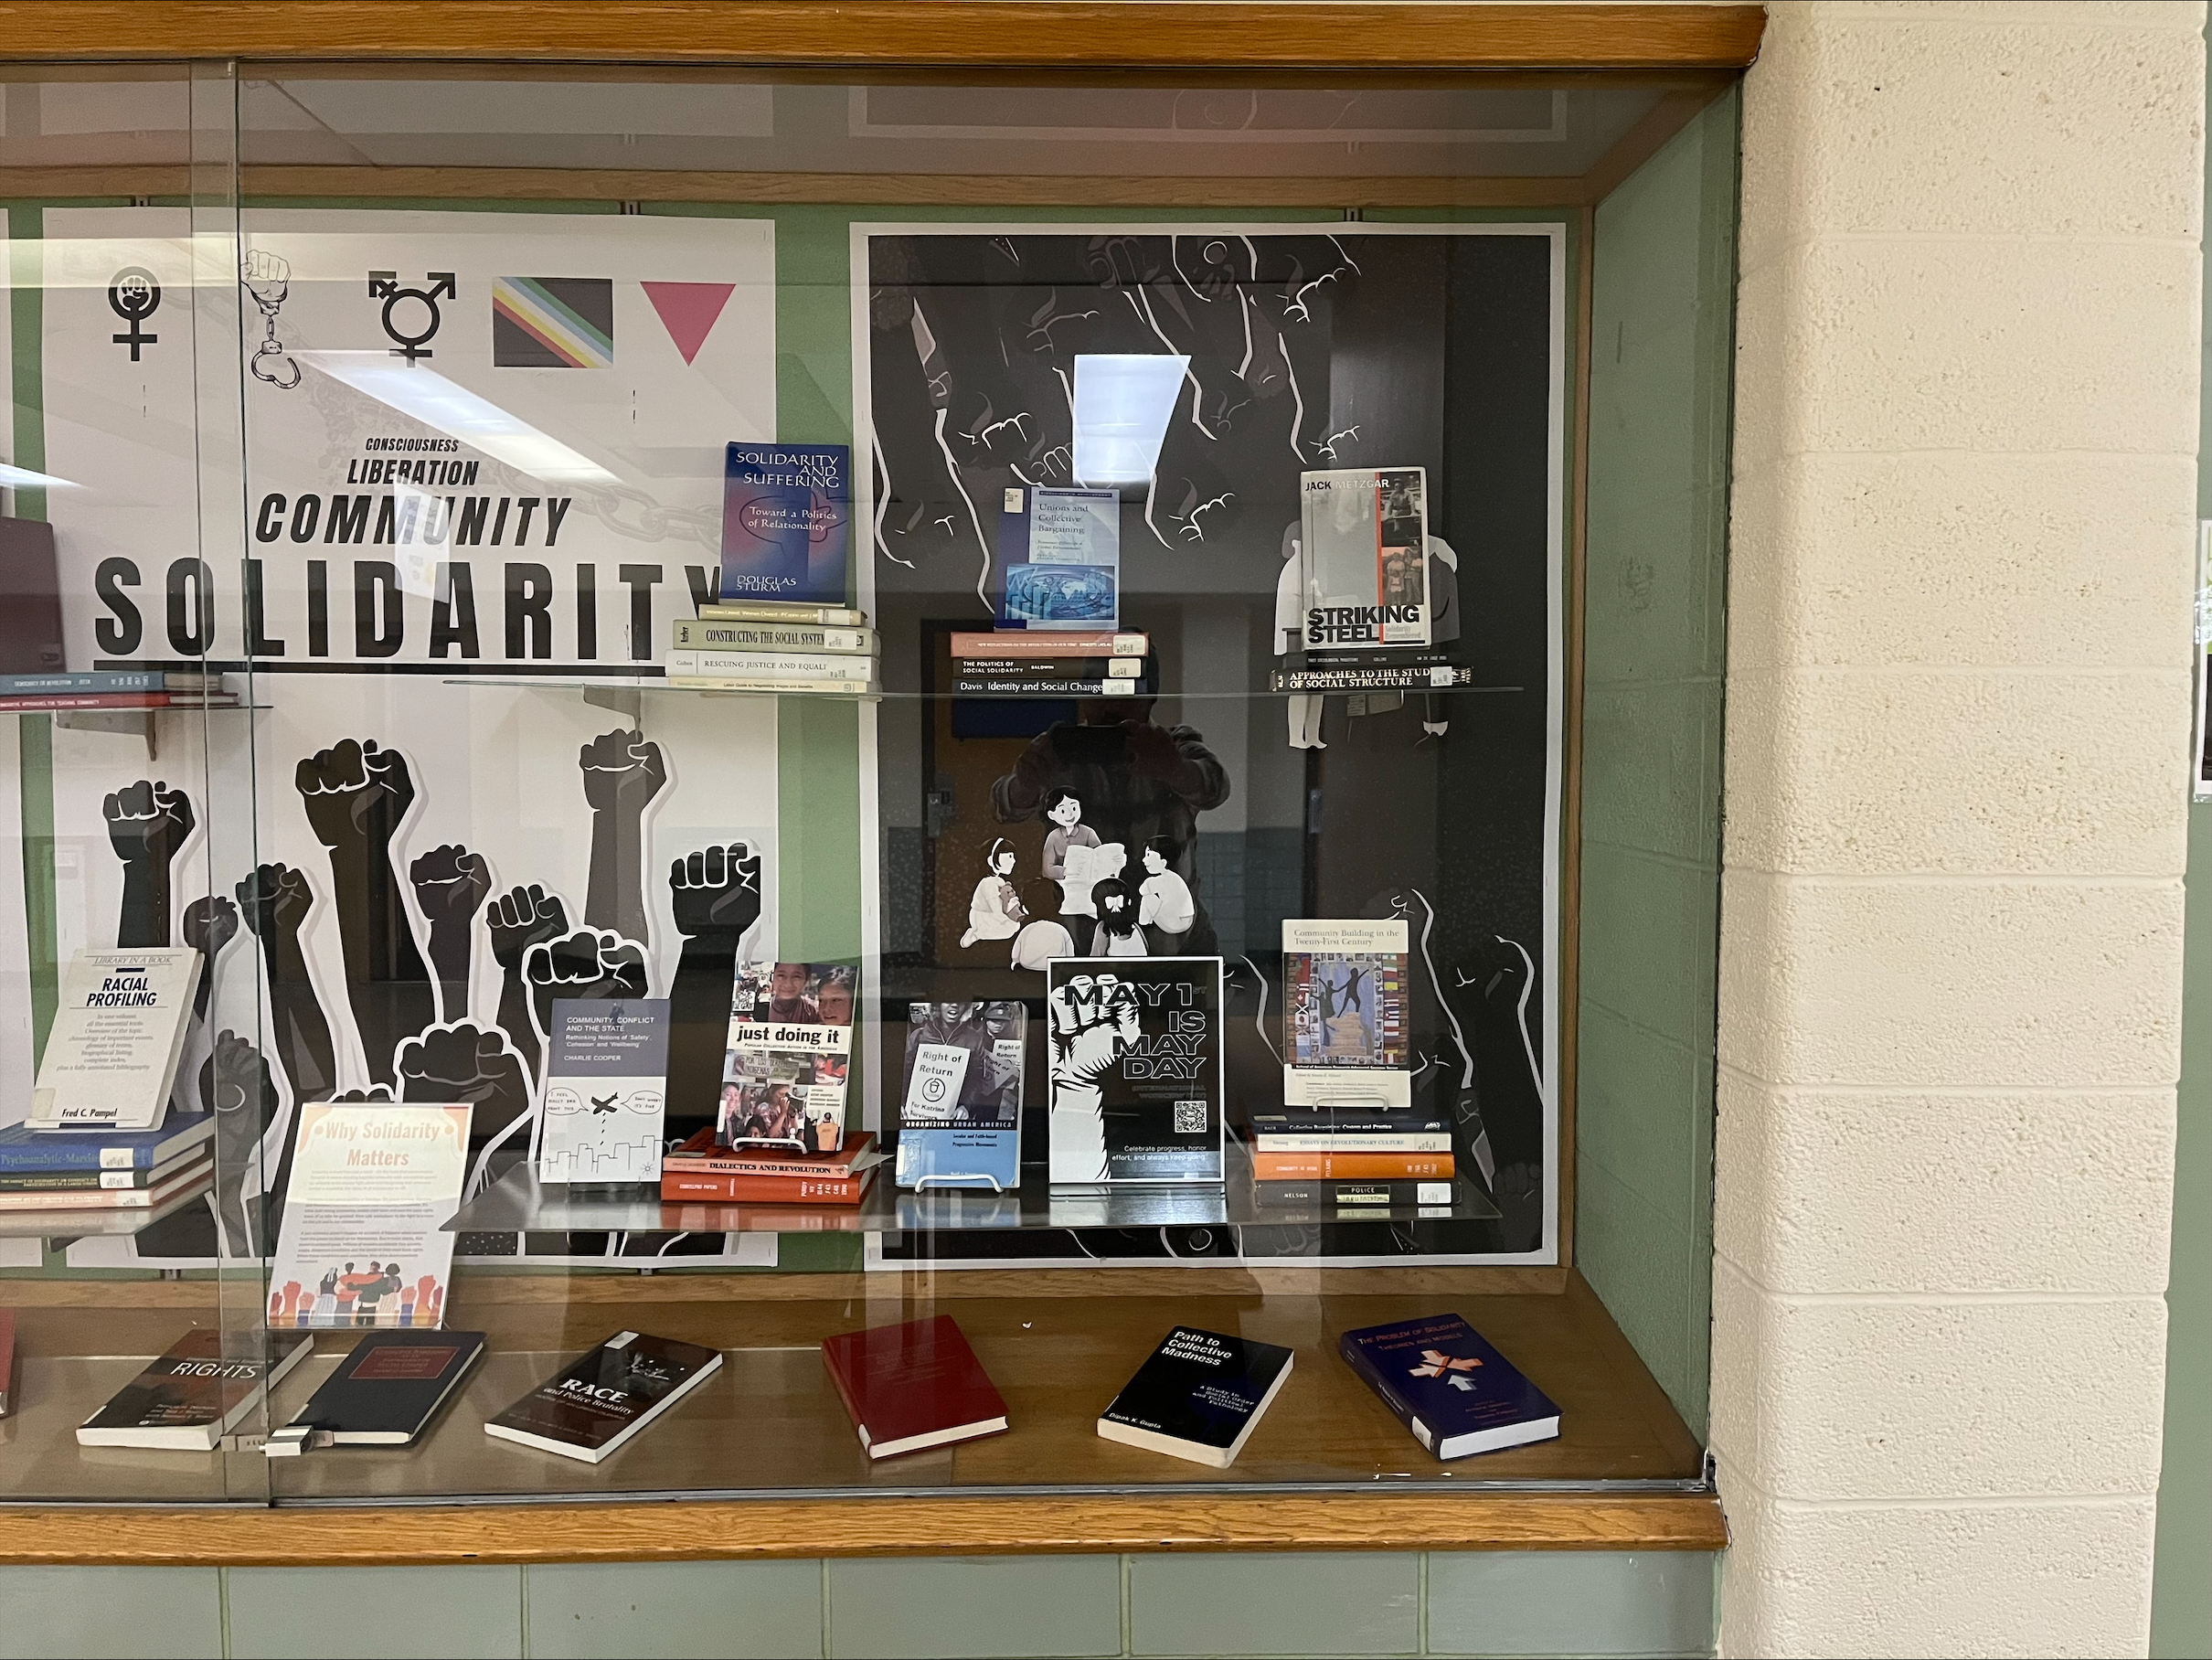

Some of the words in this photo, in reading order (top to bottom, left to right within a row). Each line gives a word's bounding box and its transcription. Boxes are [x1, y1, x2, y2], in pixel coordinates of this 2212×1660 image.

[365, 437, 459, 453] CONSCIOUSNESS
[735, 451, 839, 467] SOLIDARITY
[346, 459, 480, 485] LIBERATION
[798, 464, 837, 477] AND
[742, 472, 840, 488] SUFFERING
[1304, 481, 1332, 492] JACK
[1335, 478, 1390, 490] METZGAR
[748, 505, 786, 517] Toward
[802, 508, 837, 520] Politics
[1037, 503, 1070, 513] Unions
[1072, 504, 1089, 512] and
[255, 493, 572, 548] COMMUNITY
[748, 518, 759, 528] of
[760, 518, 826, 532] Relationality
[1037, 514, 1081, 523] Collective
[1037, 524, 1085, 535] Bargaining
[735, 582, 782, 592] STURM
[736, 574, 797, 586] DOUGLAS
[1307, 604, 1420, 626] STRIKING
[706, 629, 759, 644] CONSTRUCTING
[760, 631, 774, 644] THE
[774, 631, 801, 644] SOCIAL
[1307, 623, 1380, 644] STEEL
[704, 660, 744, 668] RESCUING
[745, 661, 777, 669] JUSTICE
[1289, 669, 1357, 681] APPROACHES
[1359, 669, 1376, 678] TO
[1376, 669, 1399, 678] THE
[960, 681, 984, 691] Davis
[987, 681, 1021, 693] Identity
[1021, 682, 1039, 691] and
[1041, 681, 1068, 691] Social
[1069, 682, 1104, 694] Change
[1289, 679, 1304, 690] OF
[1305, 678, 1346, 689] SOCIAL
[1347, 676, 1413, 687] STRUCTURE
[1293, 929, 1338, 938] Community
[1341, 929, 1375, 939] Building
[1294, 937, 1340, 946] Twenty-First
[1340, 938, 1373, 948] Century
[94, 956, 127, 964] LIBRARY
[101, 977, 149, 992] RACIAL
[86, 992, 157, 1007] PROFILING
[1064, 983, 1171, 1006] MAY
[1168, 1010, 1207, 1033] IS
[565, 1034, 597, 1042] Rethinking
[737, 1025, 770, 1042] just
[774, 1027, 822, 1046] doing
[826, 1028, 839, 1044] it
[997, 1044, 1016, 1052] Right
[1111, 1034, 1207, 1057] MAY
[922, 1051, 949, 1062] Right
[951, 1055, 962, 1064] of
[919, 1064, 953, 1077] Return
[1123, 1057, 1207, 1080] DAY
[61, 1108, 79, 1118] Fred
[80, 1108, 88, 1117] C.
[90, 1108, 118, 1120] Pampel
[920, 1103, 945, 1113] Katrina
[324, 1122, 357, 1143] Why
[362, 1121, 441, 1142] Solidarity
[1123, 1144, 1156, 1153] Celebrate
[346, 1148, 410, 1166] Matters
[1146, 1154, 1170, 1163] always
[708, 1162, 757, 1171] DIALECTICS
[778, 1165, 831, 1175] REVOLUTION
[1174, 1331, 1205, 1344] Path
[1207, 1337, 1221, 1347] to
[1375, 1330, 1410, 1343] PROBLEM
[1423, 1321, 1465, 1334] SOLIDARITY
[1167, 1338, 1233, 1359] Collective
[1161, 1346, 1222, 1367] Madness
[170, 1362, 262, 1379] RIGHTS
[558, 1378, 629, 1403] RACE
[1206, 1386, 1230, 1396] Study
[543, 1387, 565, 1396] and
[562, 1391, 592, 1405] Police
[590, 1399, 633, 1416] Brutality
[1207, 1395, 1245, 1408] Political
[1208, 1399, 1249, 1413] Pathology
[1231, 1396, 1255, 1406] Order
[1108, 1411, 1131, 1422] Dipak
[1139, 1420, 1162, 1430] Gupta
